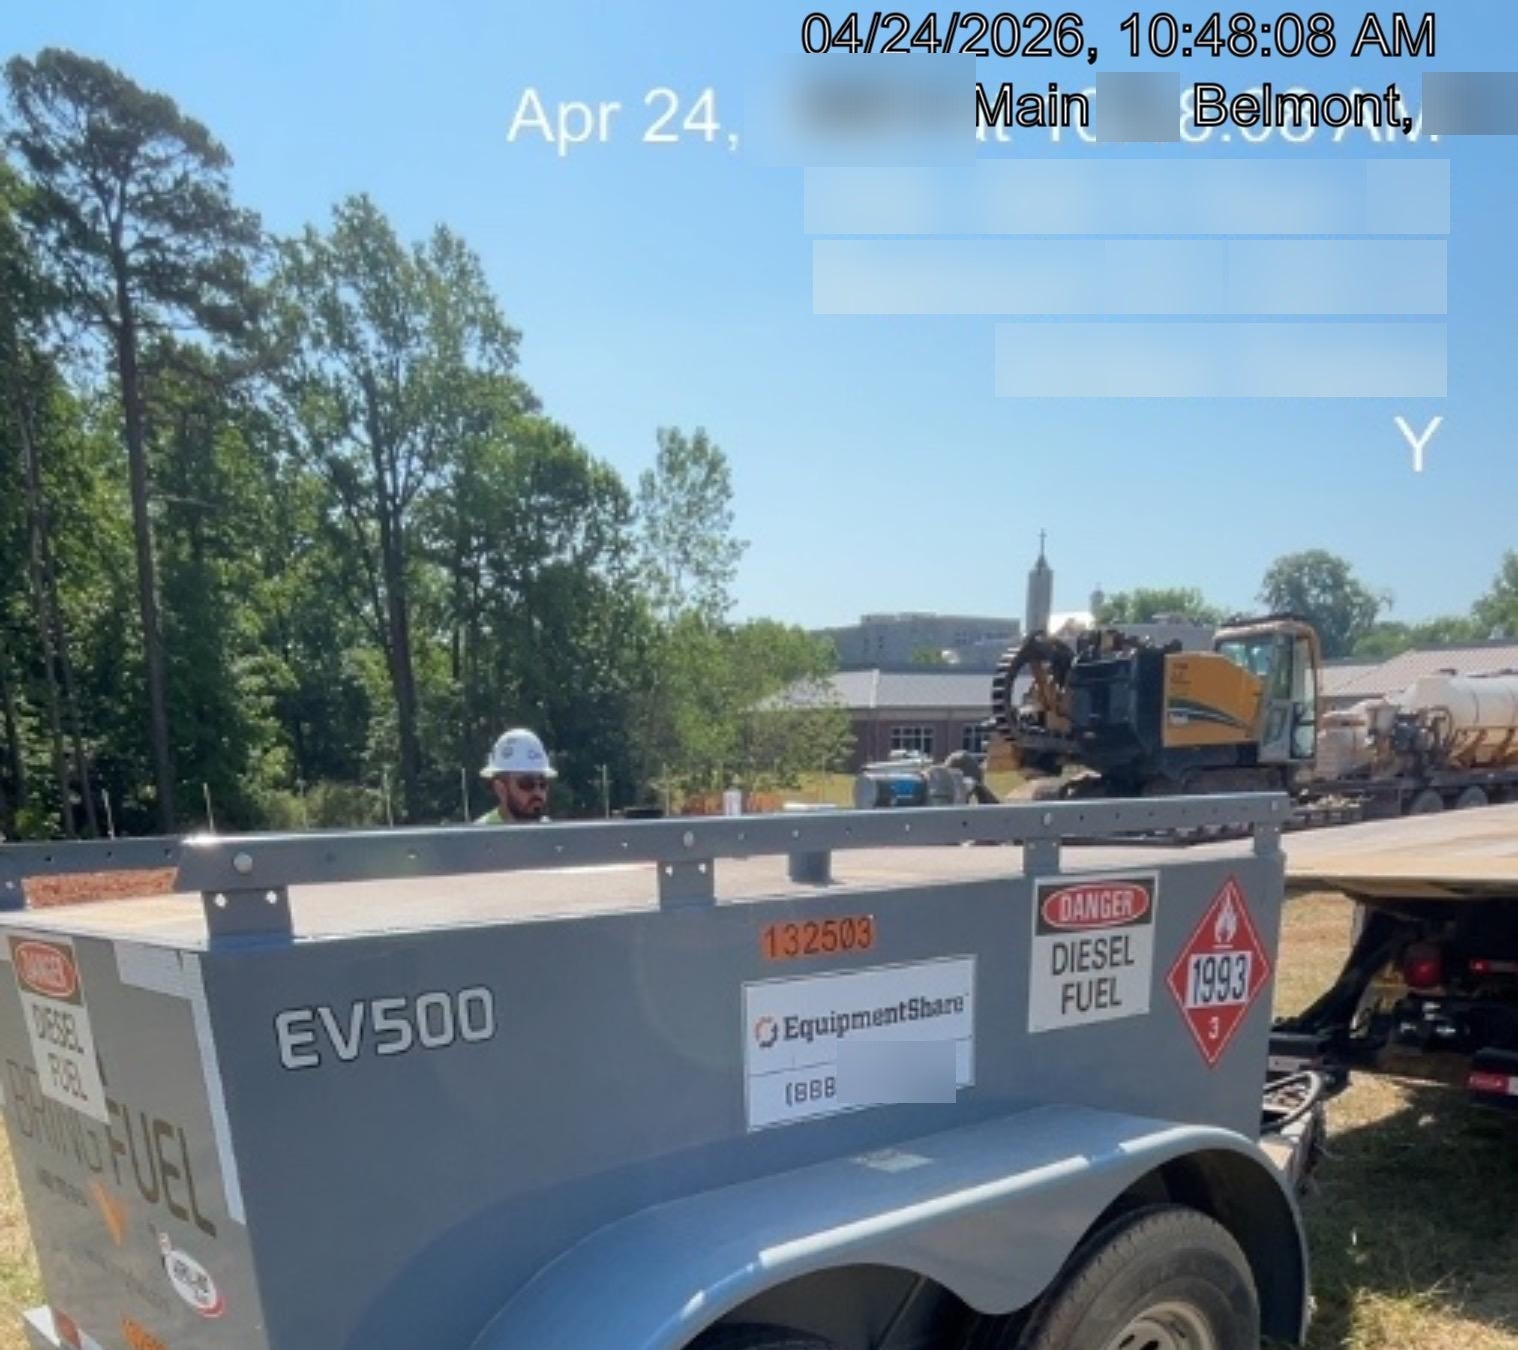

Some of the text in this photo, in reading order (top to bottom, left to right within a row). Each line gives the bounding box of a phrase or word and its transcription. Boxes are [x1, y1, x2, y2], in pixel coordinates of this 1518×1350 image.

[1058, 890, 1136, 922] DANGER
[764, 916, 873, 958] 132503
[1052, 935, 1135, 976] DIESEL
[1061, 977, 1123, 1016] FUEL
[1192, 954, 1247, 1006] 1993
[275, 985, 498, 1071] EV500
[782, 994, 966, 1043] EquipmentShare
[1207, 1015, 1221, 1040] 3
